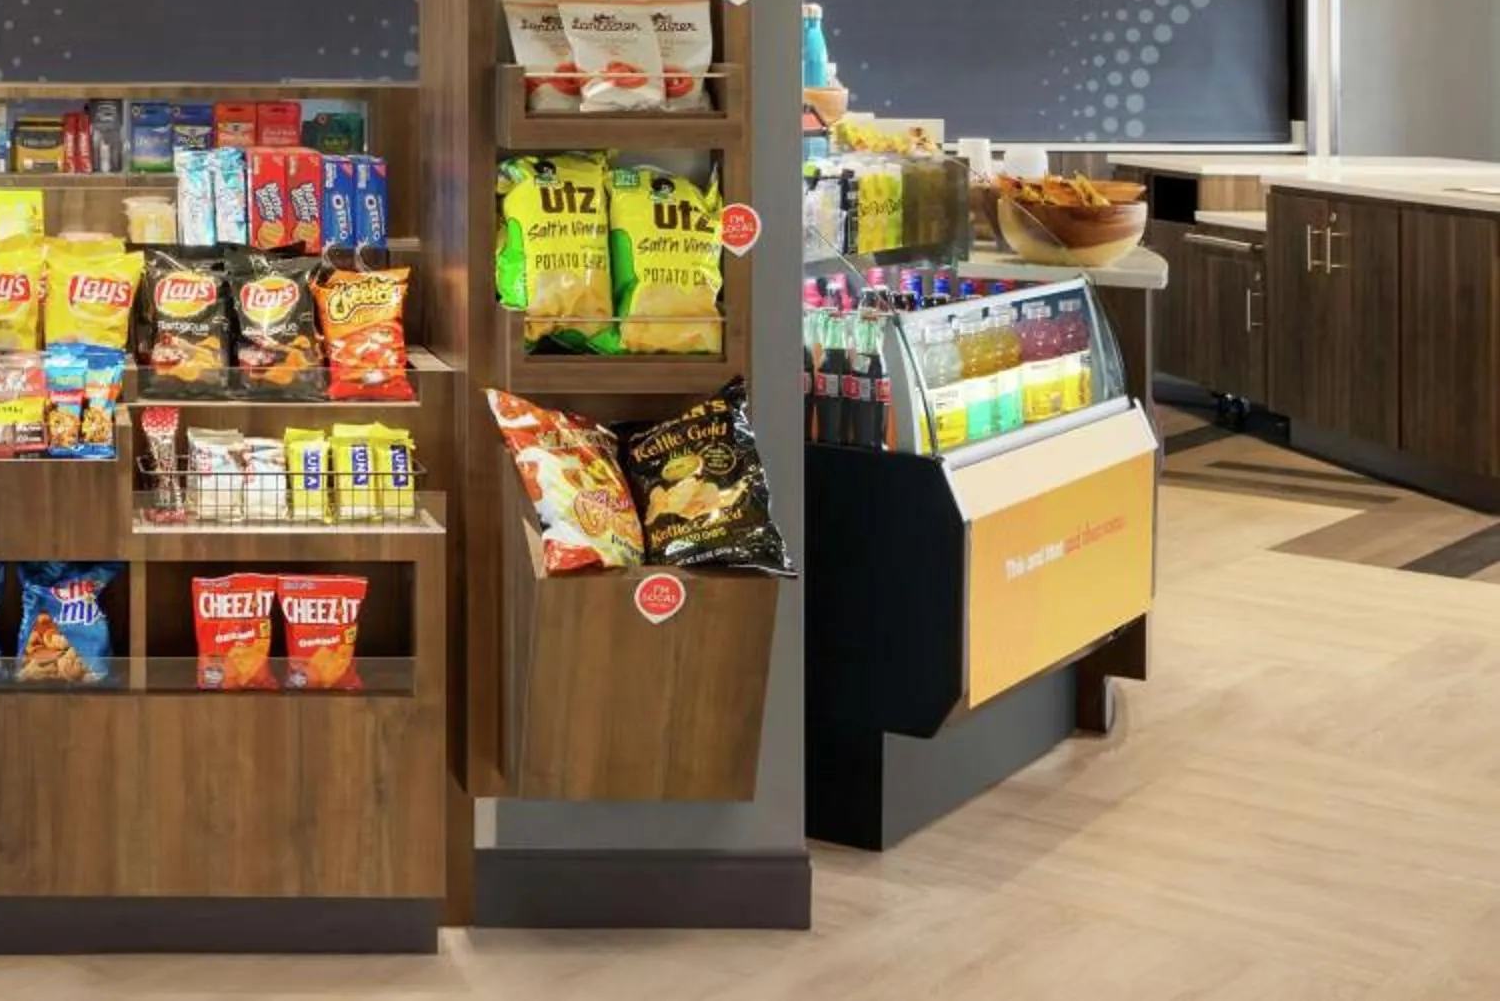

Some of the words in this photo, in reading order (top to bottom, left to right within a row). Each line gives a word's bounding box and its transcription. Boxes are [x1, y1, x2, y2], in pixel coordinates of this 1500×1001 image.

[535, 254, 580, 270] POTATO
[643, 267, 688, 286] POTATO
[687, 422, 728, 441] Gold
